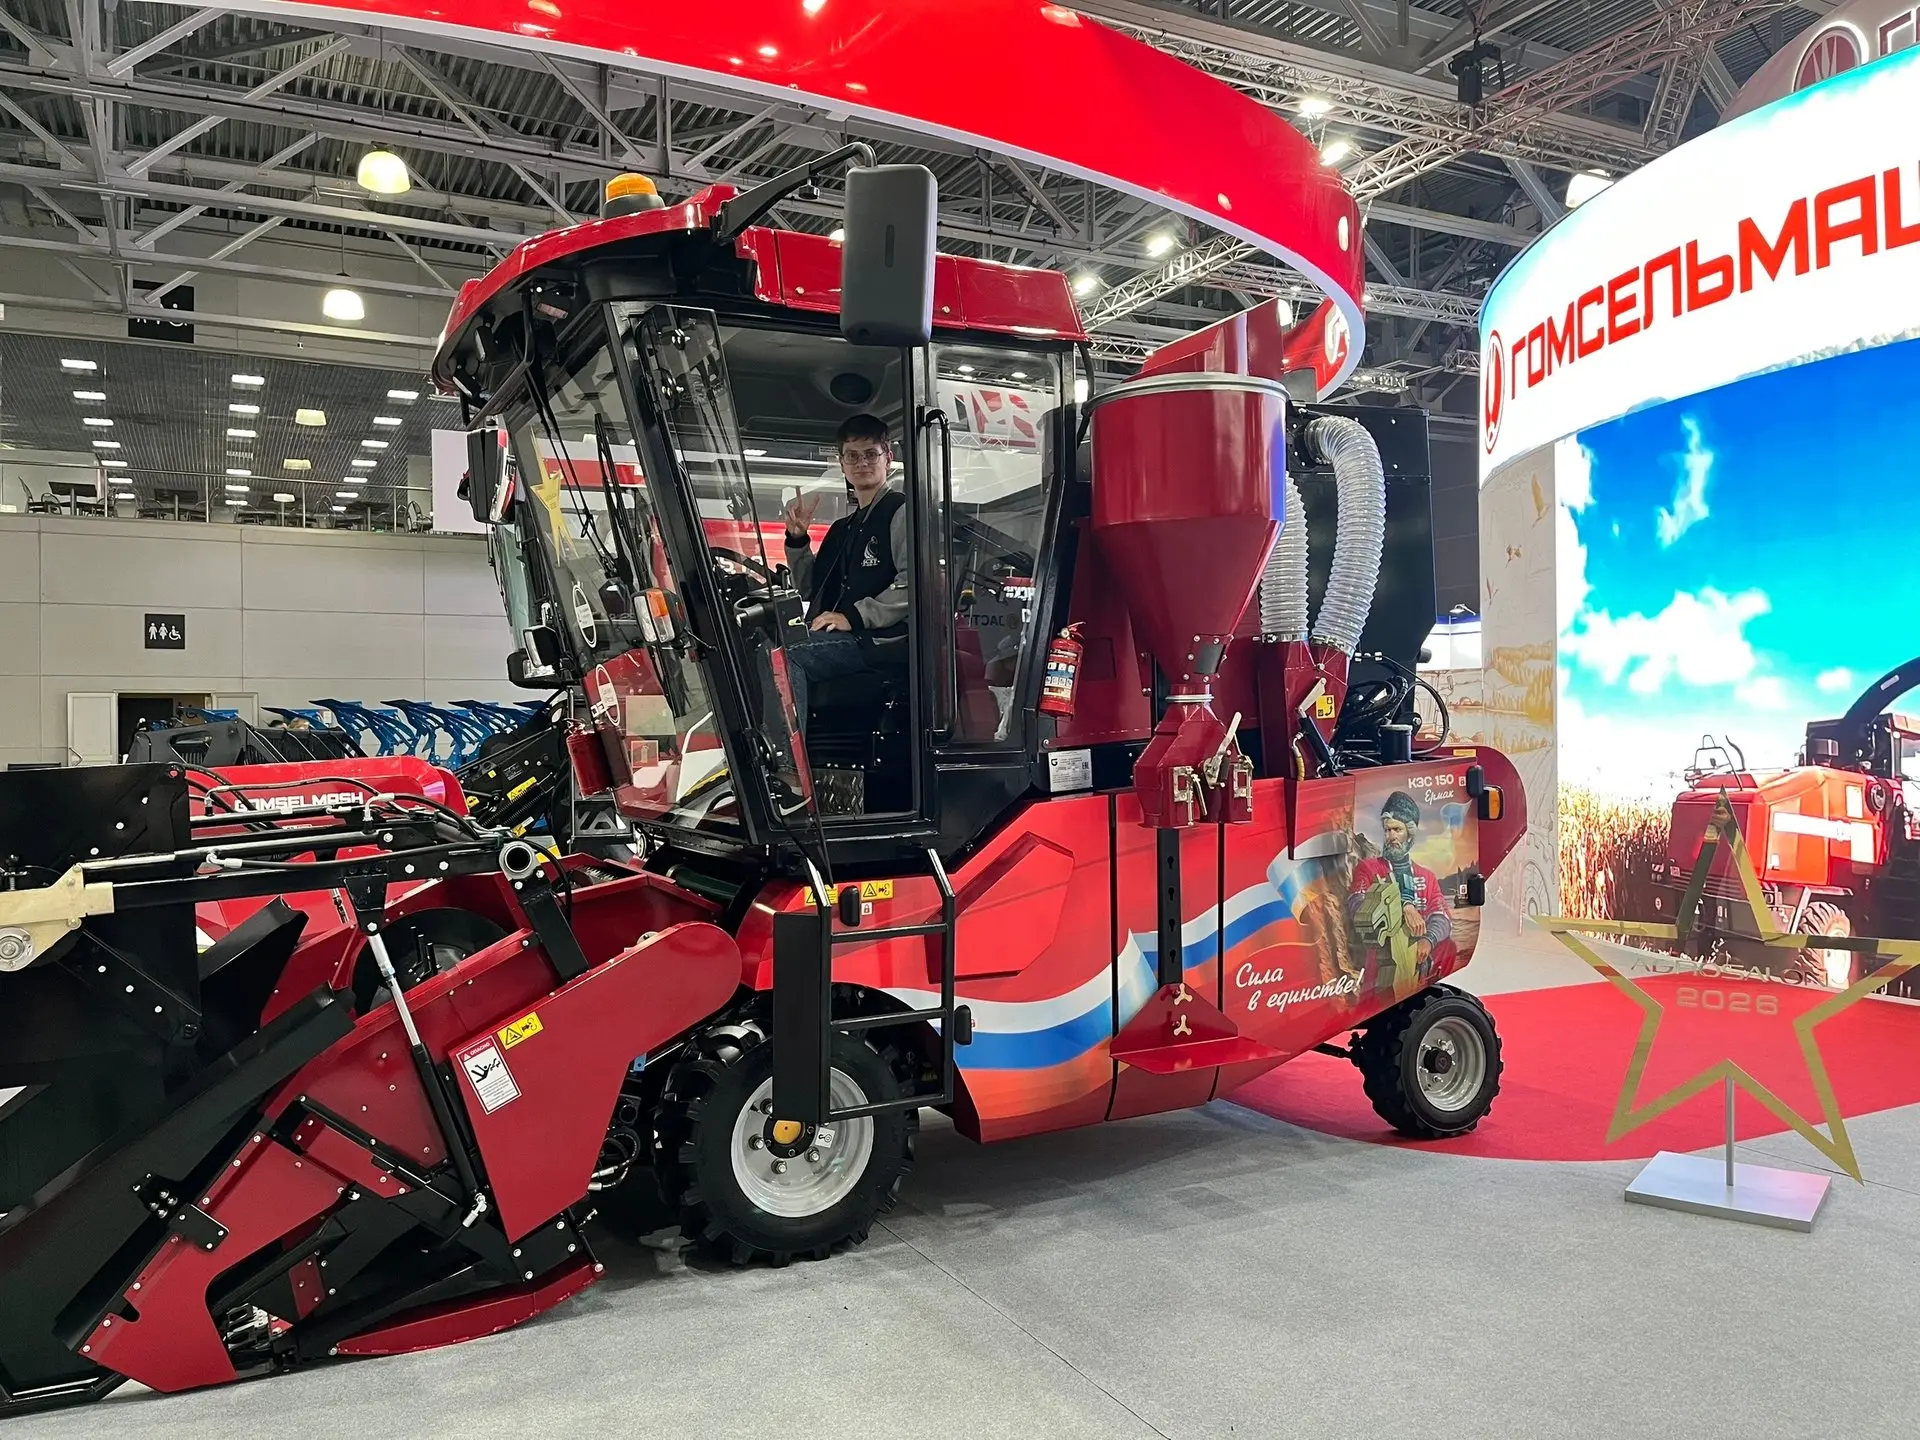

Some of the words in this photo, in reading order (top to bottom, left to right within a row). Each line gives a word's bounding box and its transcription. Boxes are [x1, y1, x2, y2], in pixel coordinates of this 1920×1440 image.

[1408, 776, 1433, 789] КЗС
[1434, 773, 1455, 786] 150
[1424, 788, 1455, 806] Ермак
[1235, 962, 1284, 988] Сила
[1247, 989, 1262, 1012] в
[1266, 967, 1366, 1013] единстве!
[1676, 987, 1779, 1016] 2026
